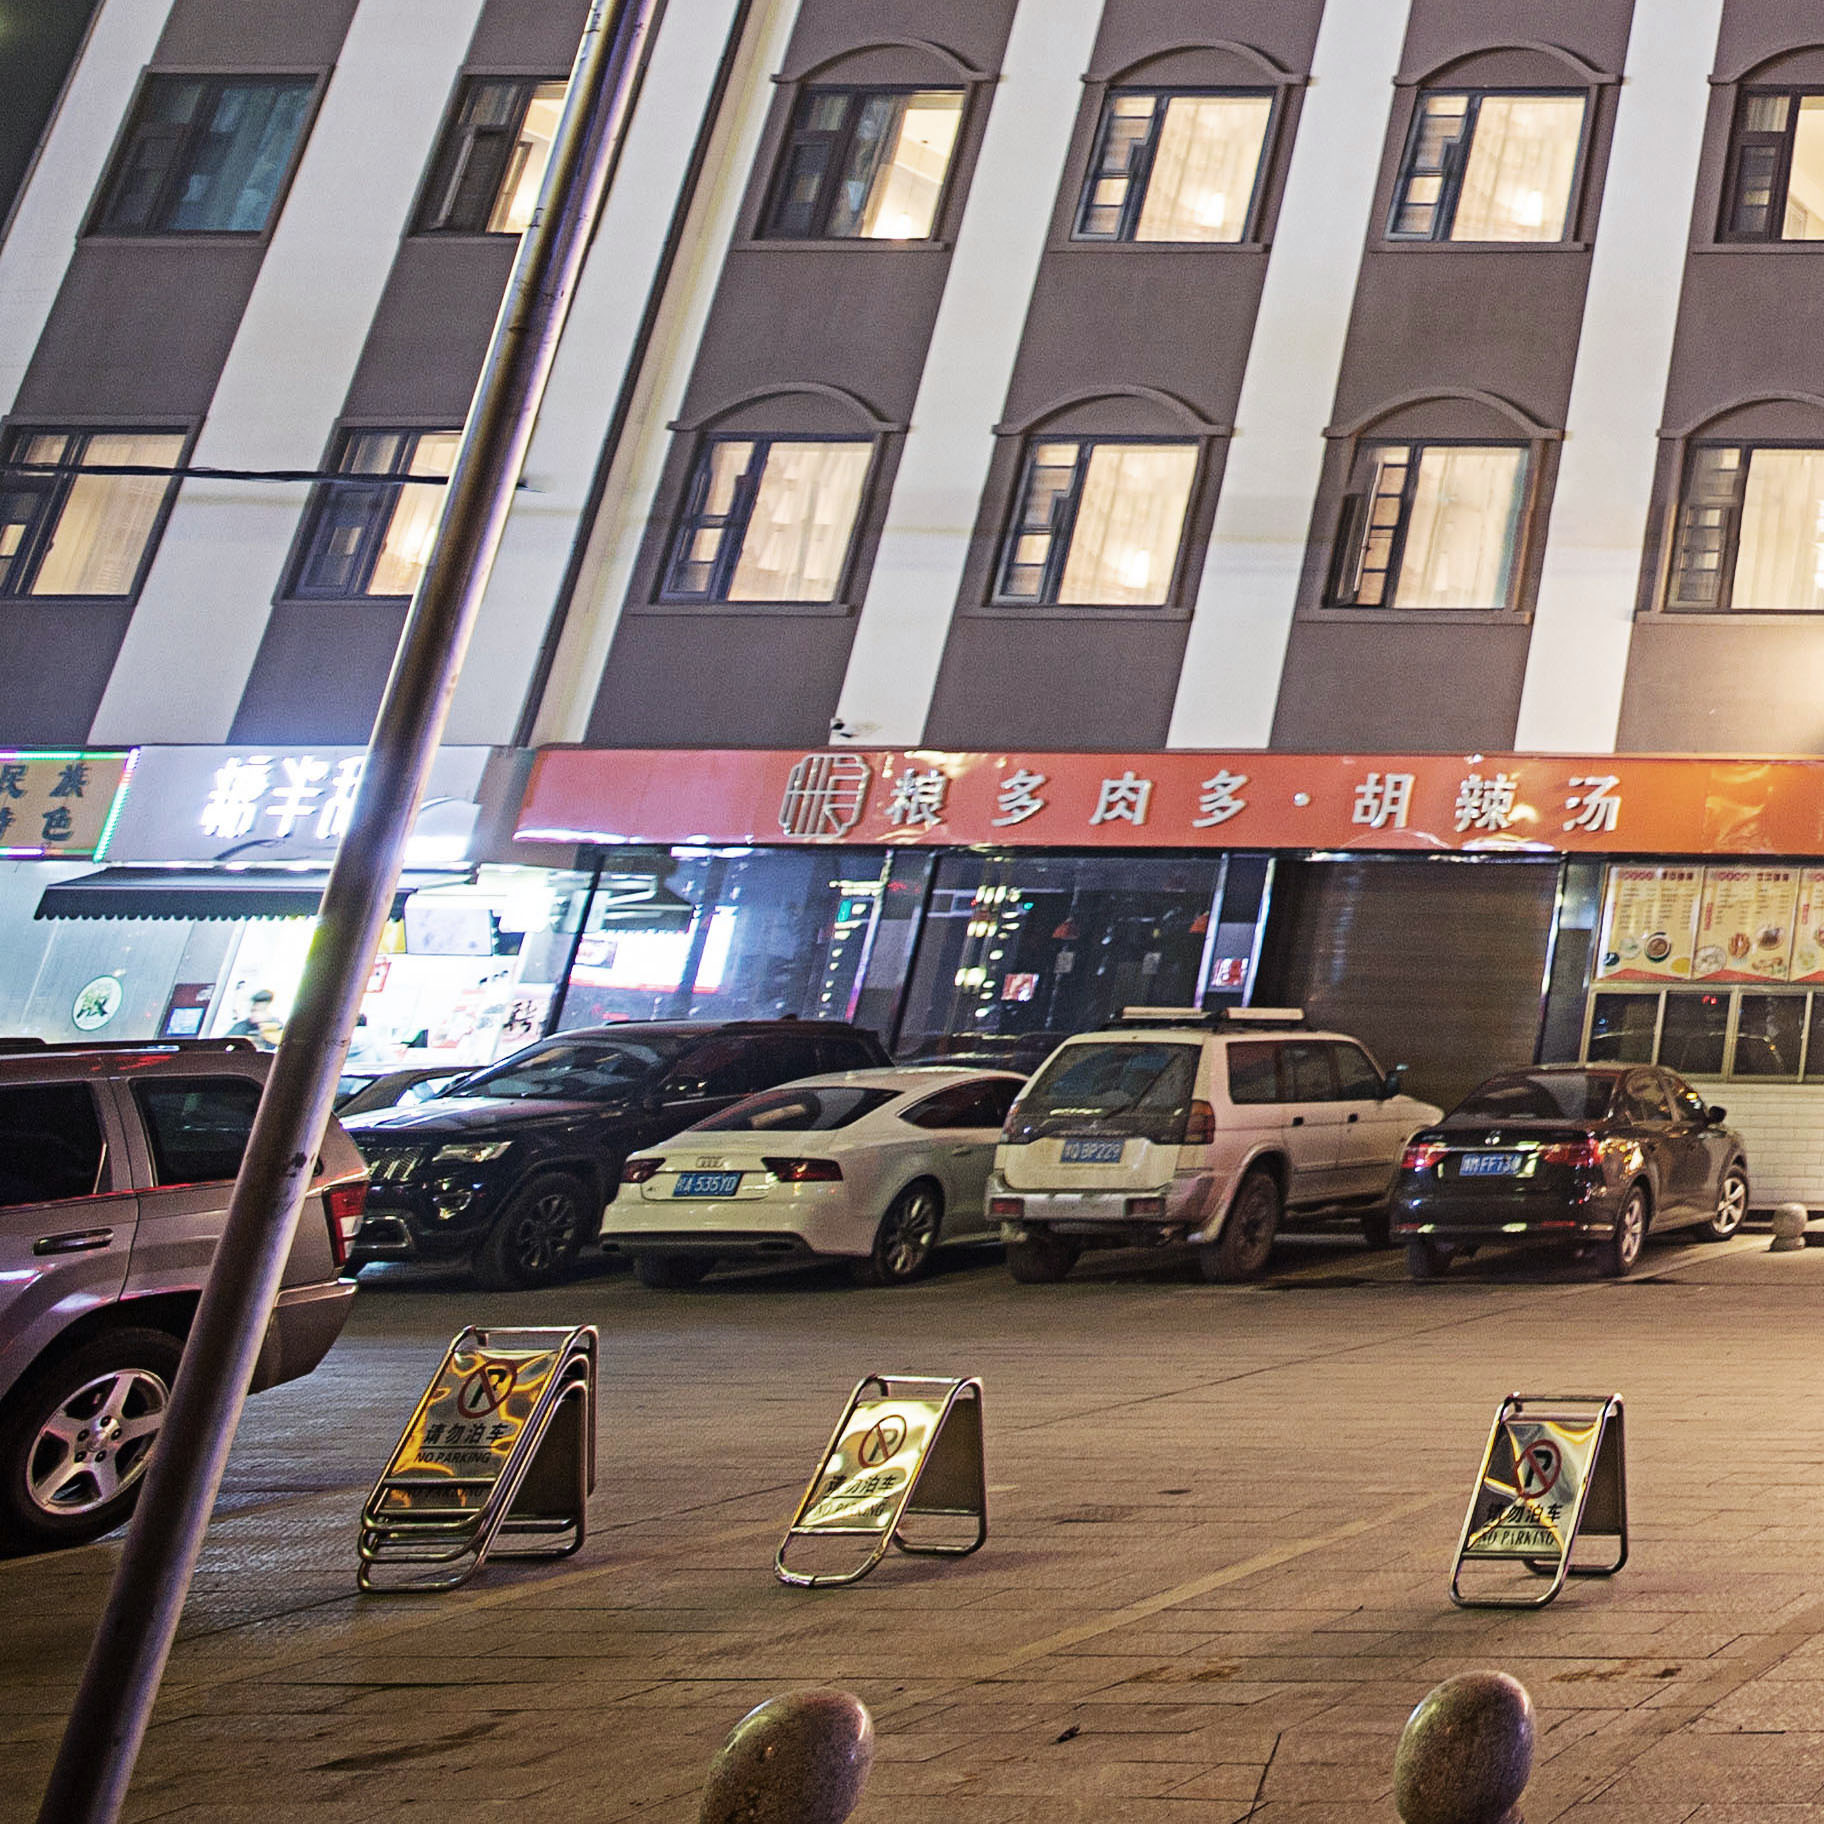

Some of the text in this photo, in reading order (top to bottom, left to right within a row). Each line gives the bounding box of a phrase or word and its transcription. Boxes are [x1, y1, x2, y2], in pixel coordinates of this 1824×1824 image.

[424, 1423, 509, 1444] 请勿泊车
[414, 1452, 492, 1464] NO PARKING
